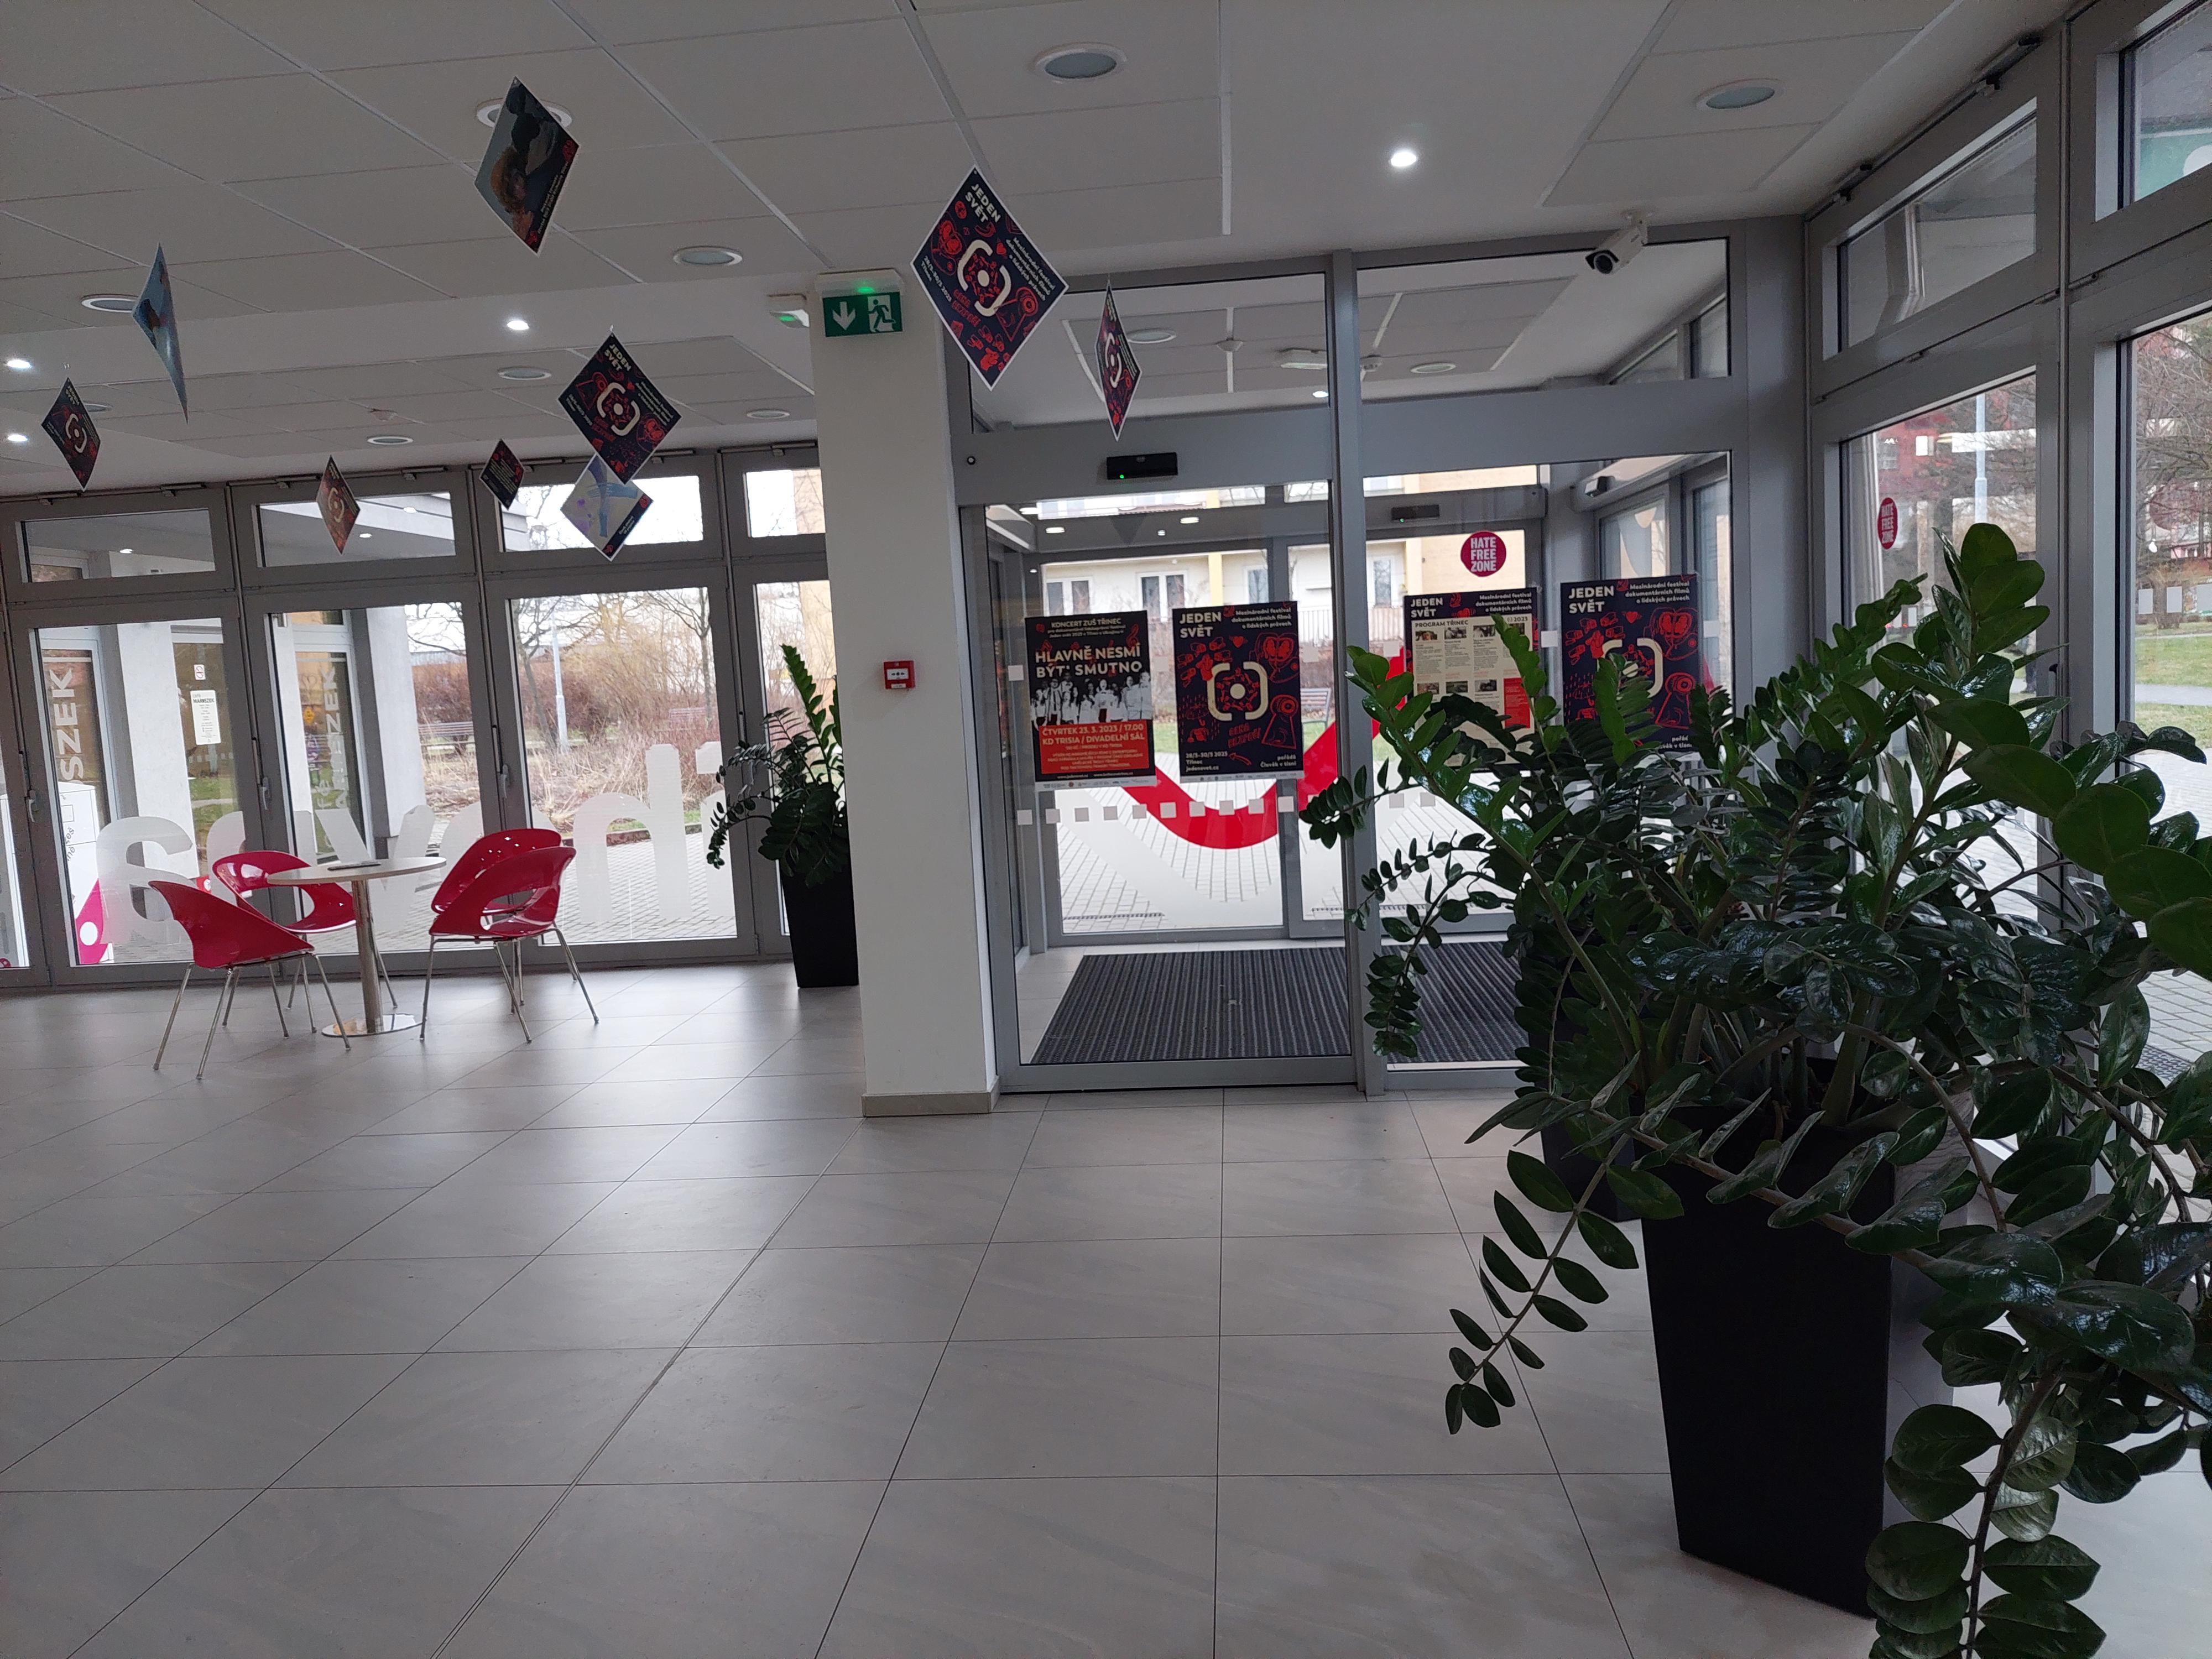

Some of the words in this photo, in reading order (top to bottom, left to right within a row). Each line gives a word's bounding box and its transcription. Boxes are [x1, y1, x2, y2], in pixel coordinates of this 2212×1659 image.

[965, 191, 989, 222] SVĚT
[971, 184, 1001, 222] JEDEN
[604, 349, 622, 371] SVĚT
[609, 344, 632, 371] JEDEN
[1470, 536, 1496, 549] HATE
[1470, 549, 1496, 560] FREE
[1471, 560, 1496, 572] ZONE
[1568, 586, 1614, 599] JEDEN
[1411, 597, 1443, 607] JEDEN
[1569, 599, 1605, 614] SVĚT
[1180, 612, 1222, 624] JEDEN
[1411, 607, 1436, 618] SVĚT
[1051, 619, 1082, 628] KONCERT
[1083, 618, 1096, 627] ZUŠ
[1098, 617, 1121, 625] TŘINEC
[1180, 624, 1213, 638] SVĚT
[1035, 645, 1092, 663] HLAVNĚ
[1095, 643, 1141, 660] NESMÍ
[1075, 661, 1142, 676] SMUTNO
[49, 669, 83, 783] SZEK
[1042, 727, 1077, 736] ČTVRTEK
[1100, 724, 1118, 733] 2023
[1042, 737, 1054, 745] KD
[1055, 735, 1080, 744] TRISIA
[1086, 733, 1129, 743] DIVADELNÍ
